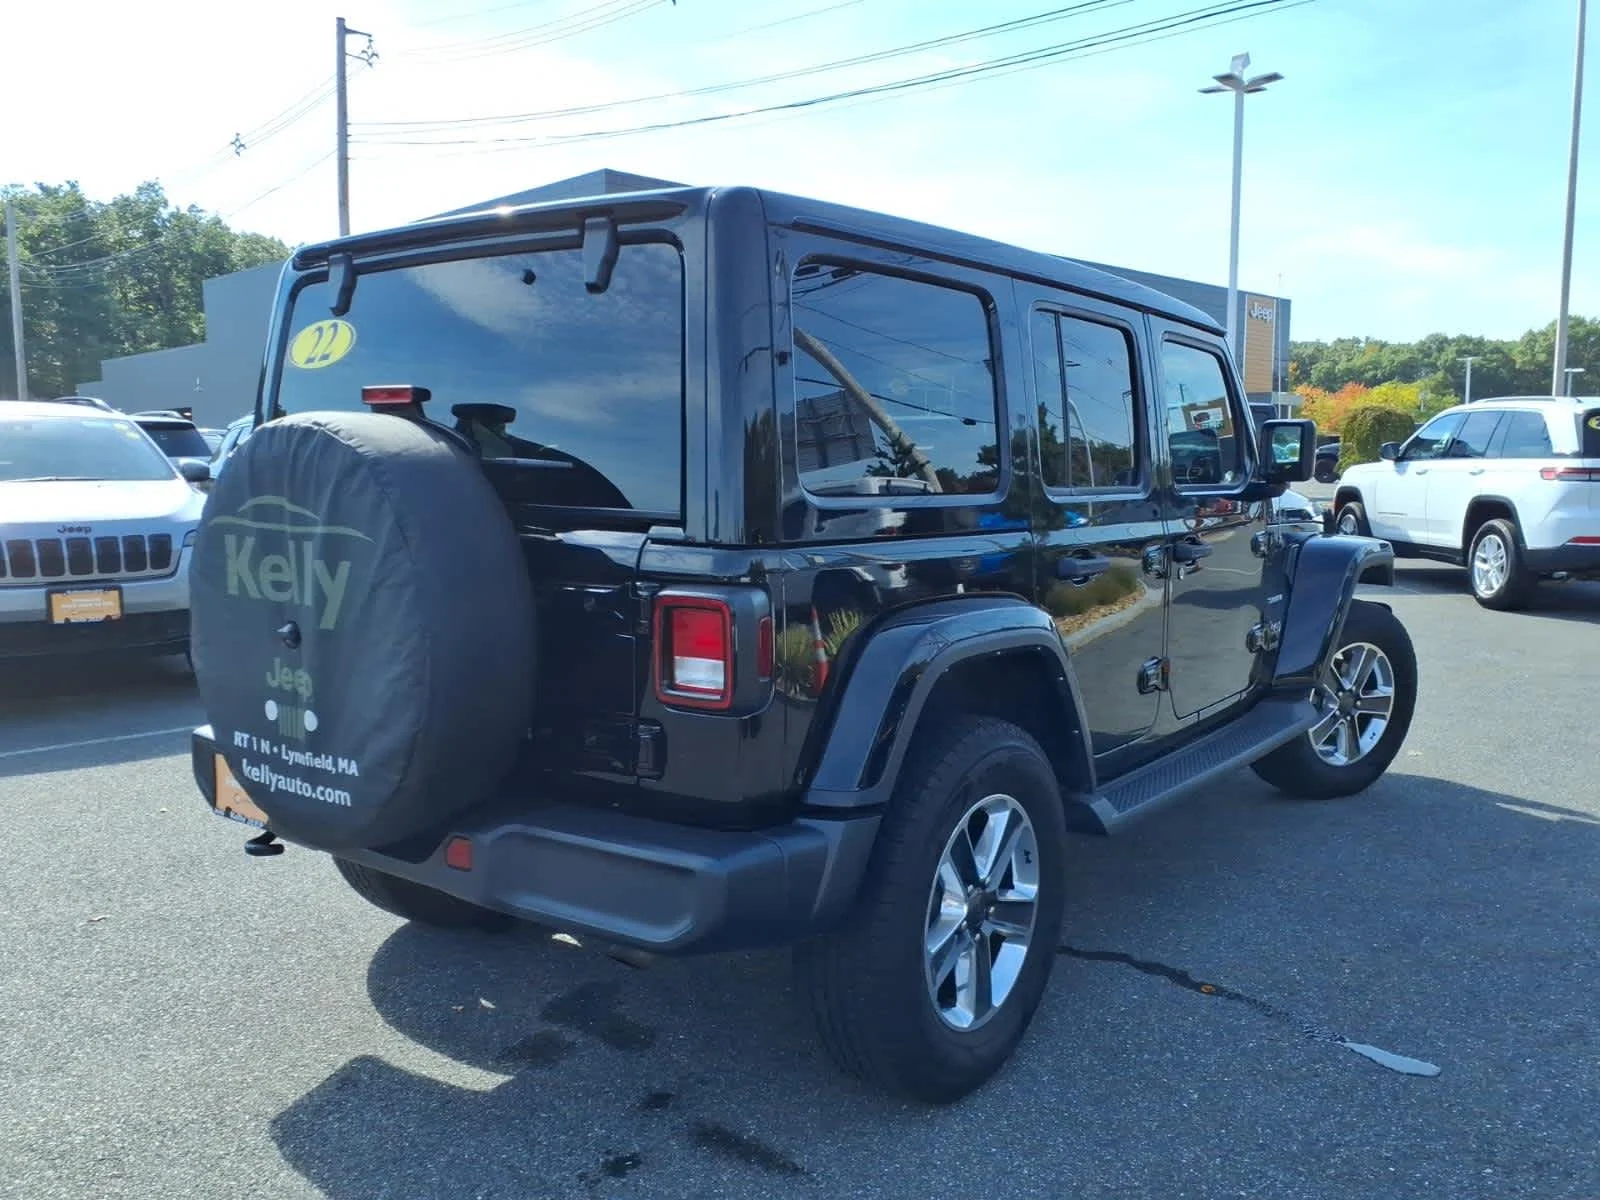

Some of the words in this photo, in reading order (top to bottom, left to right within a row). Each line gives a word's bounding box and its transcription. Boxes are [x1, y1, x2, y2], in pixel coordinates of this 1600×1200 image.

[1249, 301, 1273, 322] Jeep
[303, 321, 339, 365] 22
[57, 524, 92, 535] Jeep
[223, 533, 352, 631] Kelly
[265, 656, 313, 699] Jeep
[233, 730, 250, 748] RT
[260, 738, 271, 755] N
[337, 757, 360, 777] MA
[241, 758, 352, 807] kellyauto.com
